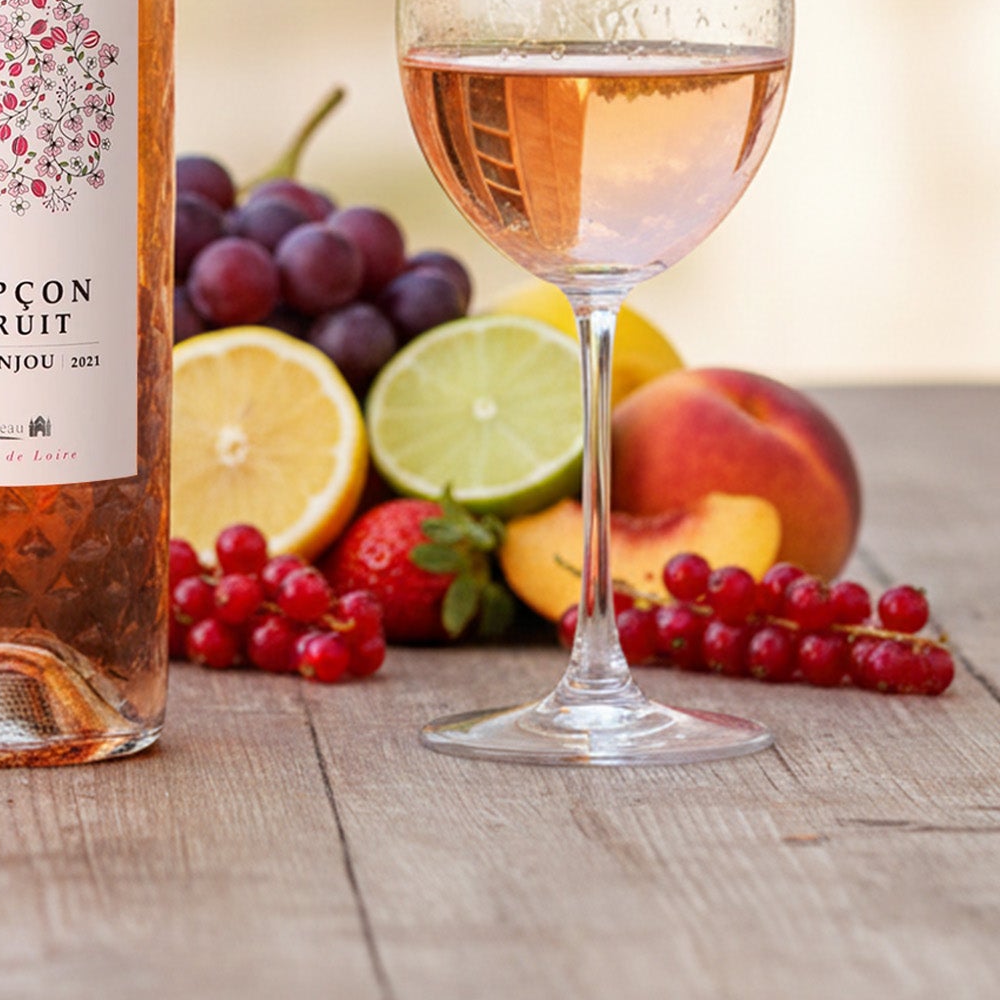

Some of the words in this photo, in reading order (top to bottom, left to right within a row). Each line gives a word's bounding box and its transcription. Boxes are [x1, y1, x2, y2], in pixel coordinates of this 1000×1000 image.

[70, 354, 101, 369] 2021
[5, 449, 24, 462] de
[33, 448, 79, 462] Loire
